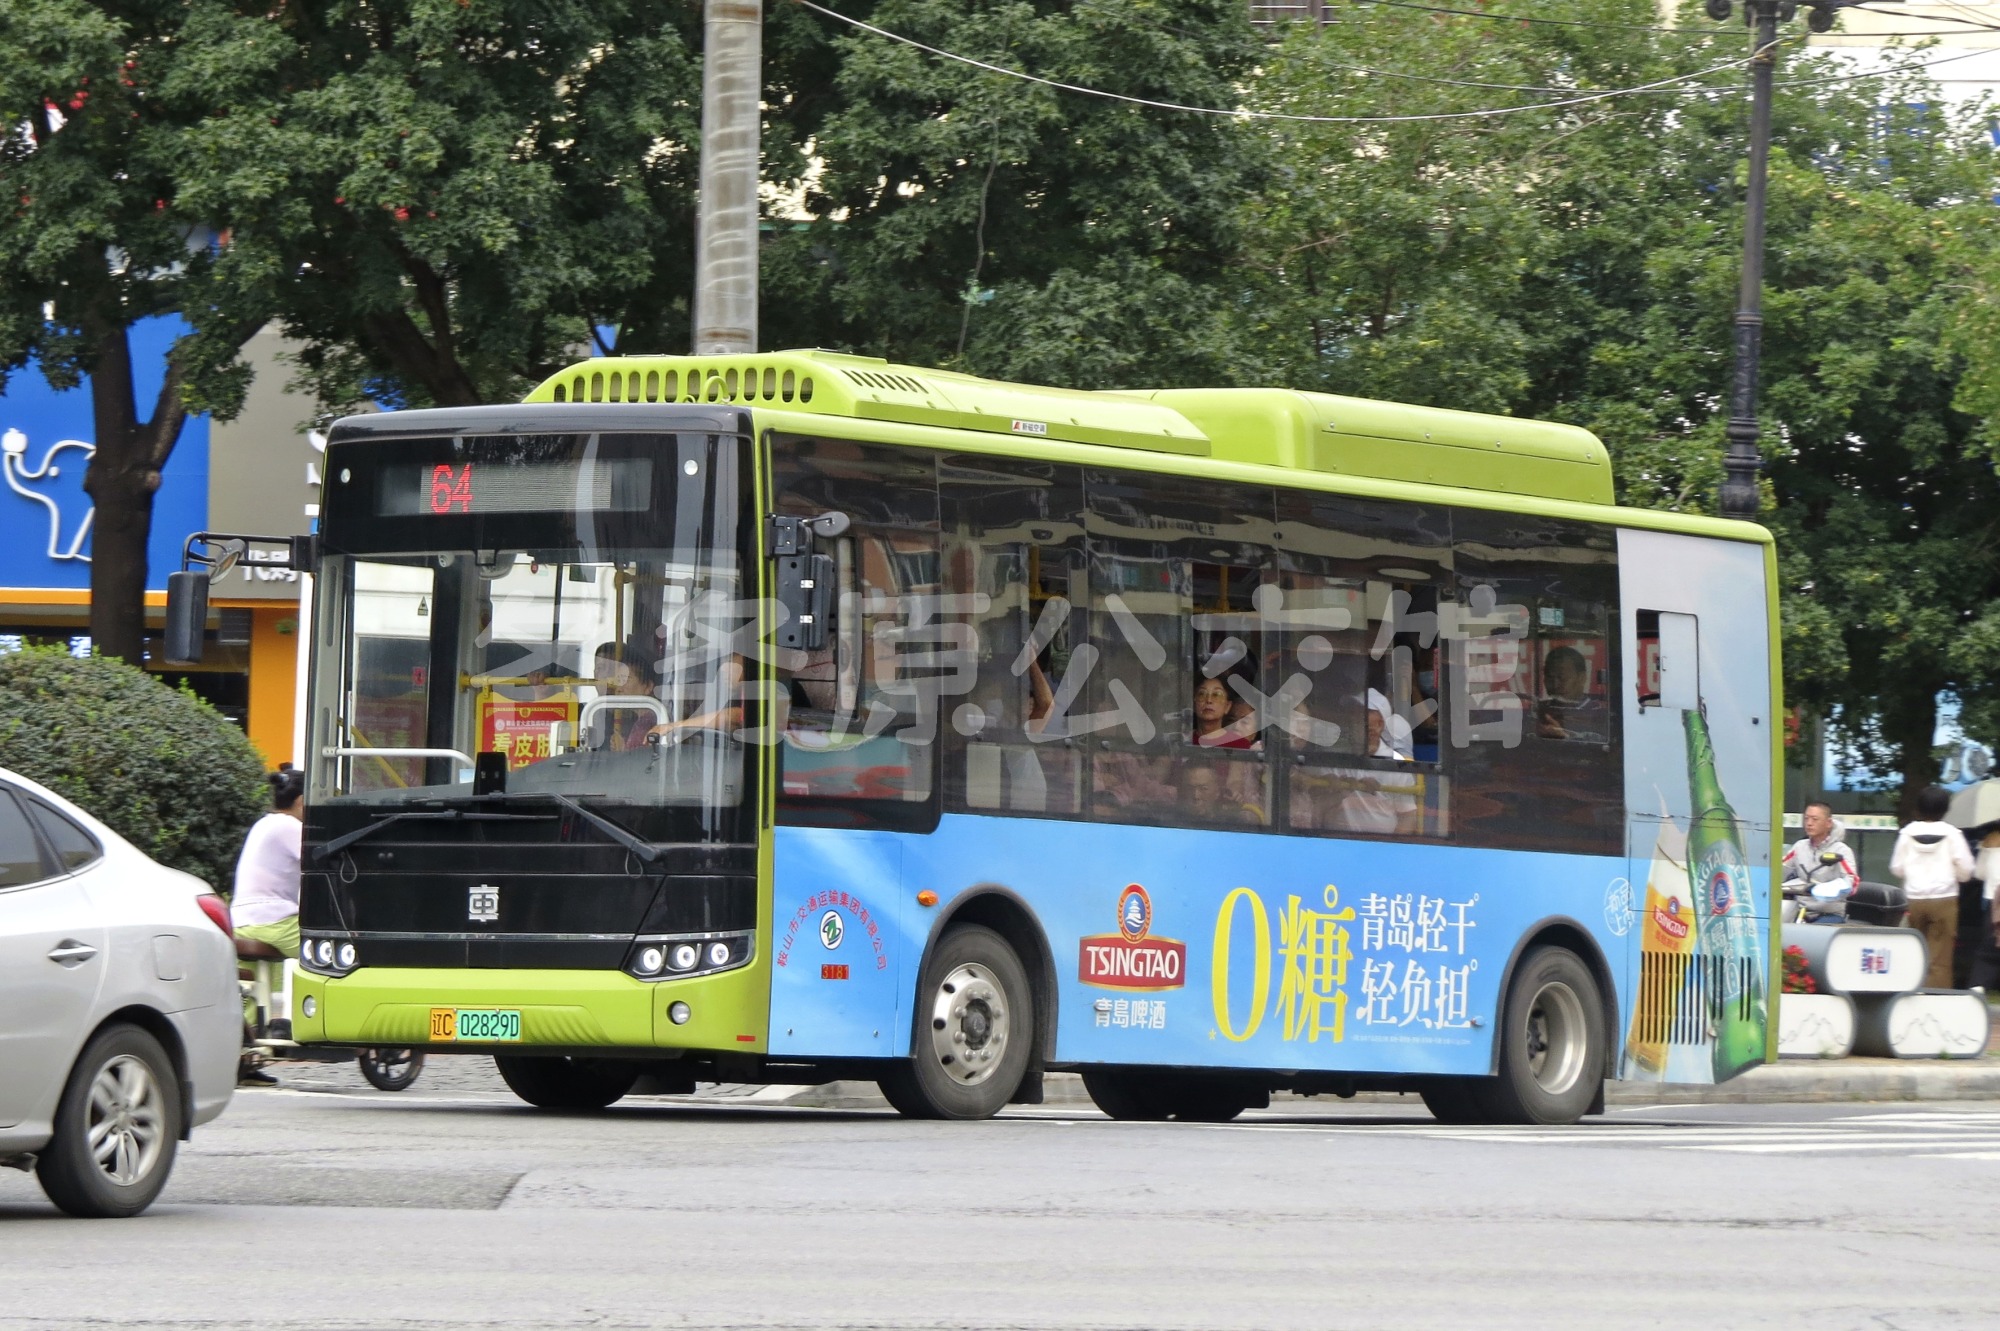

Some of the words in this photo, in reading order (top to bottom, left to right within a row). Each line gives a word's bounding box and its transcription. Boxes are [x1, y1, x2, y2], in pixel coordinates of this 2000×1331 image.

[431, 464, 473, 513] 64
[777, 889, 887, 970] 鞍山市交通运输集团有限公司
[822, 964, 849, 980] 3181
[1086, 946, 1180, 979] TSINGTAO
[461, 1014, 519, 1036] 02829D
